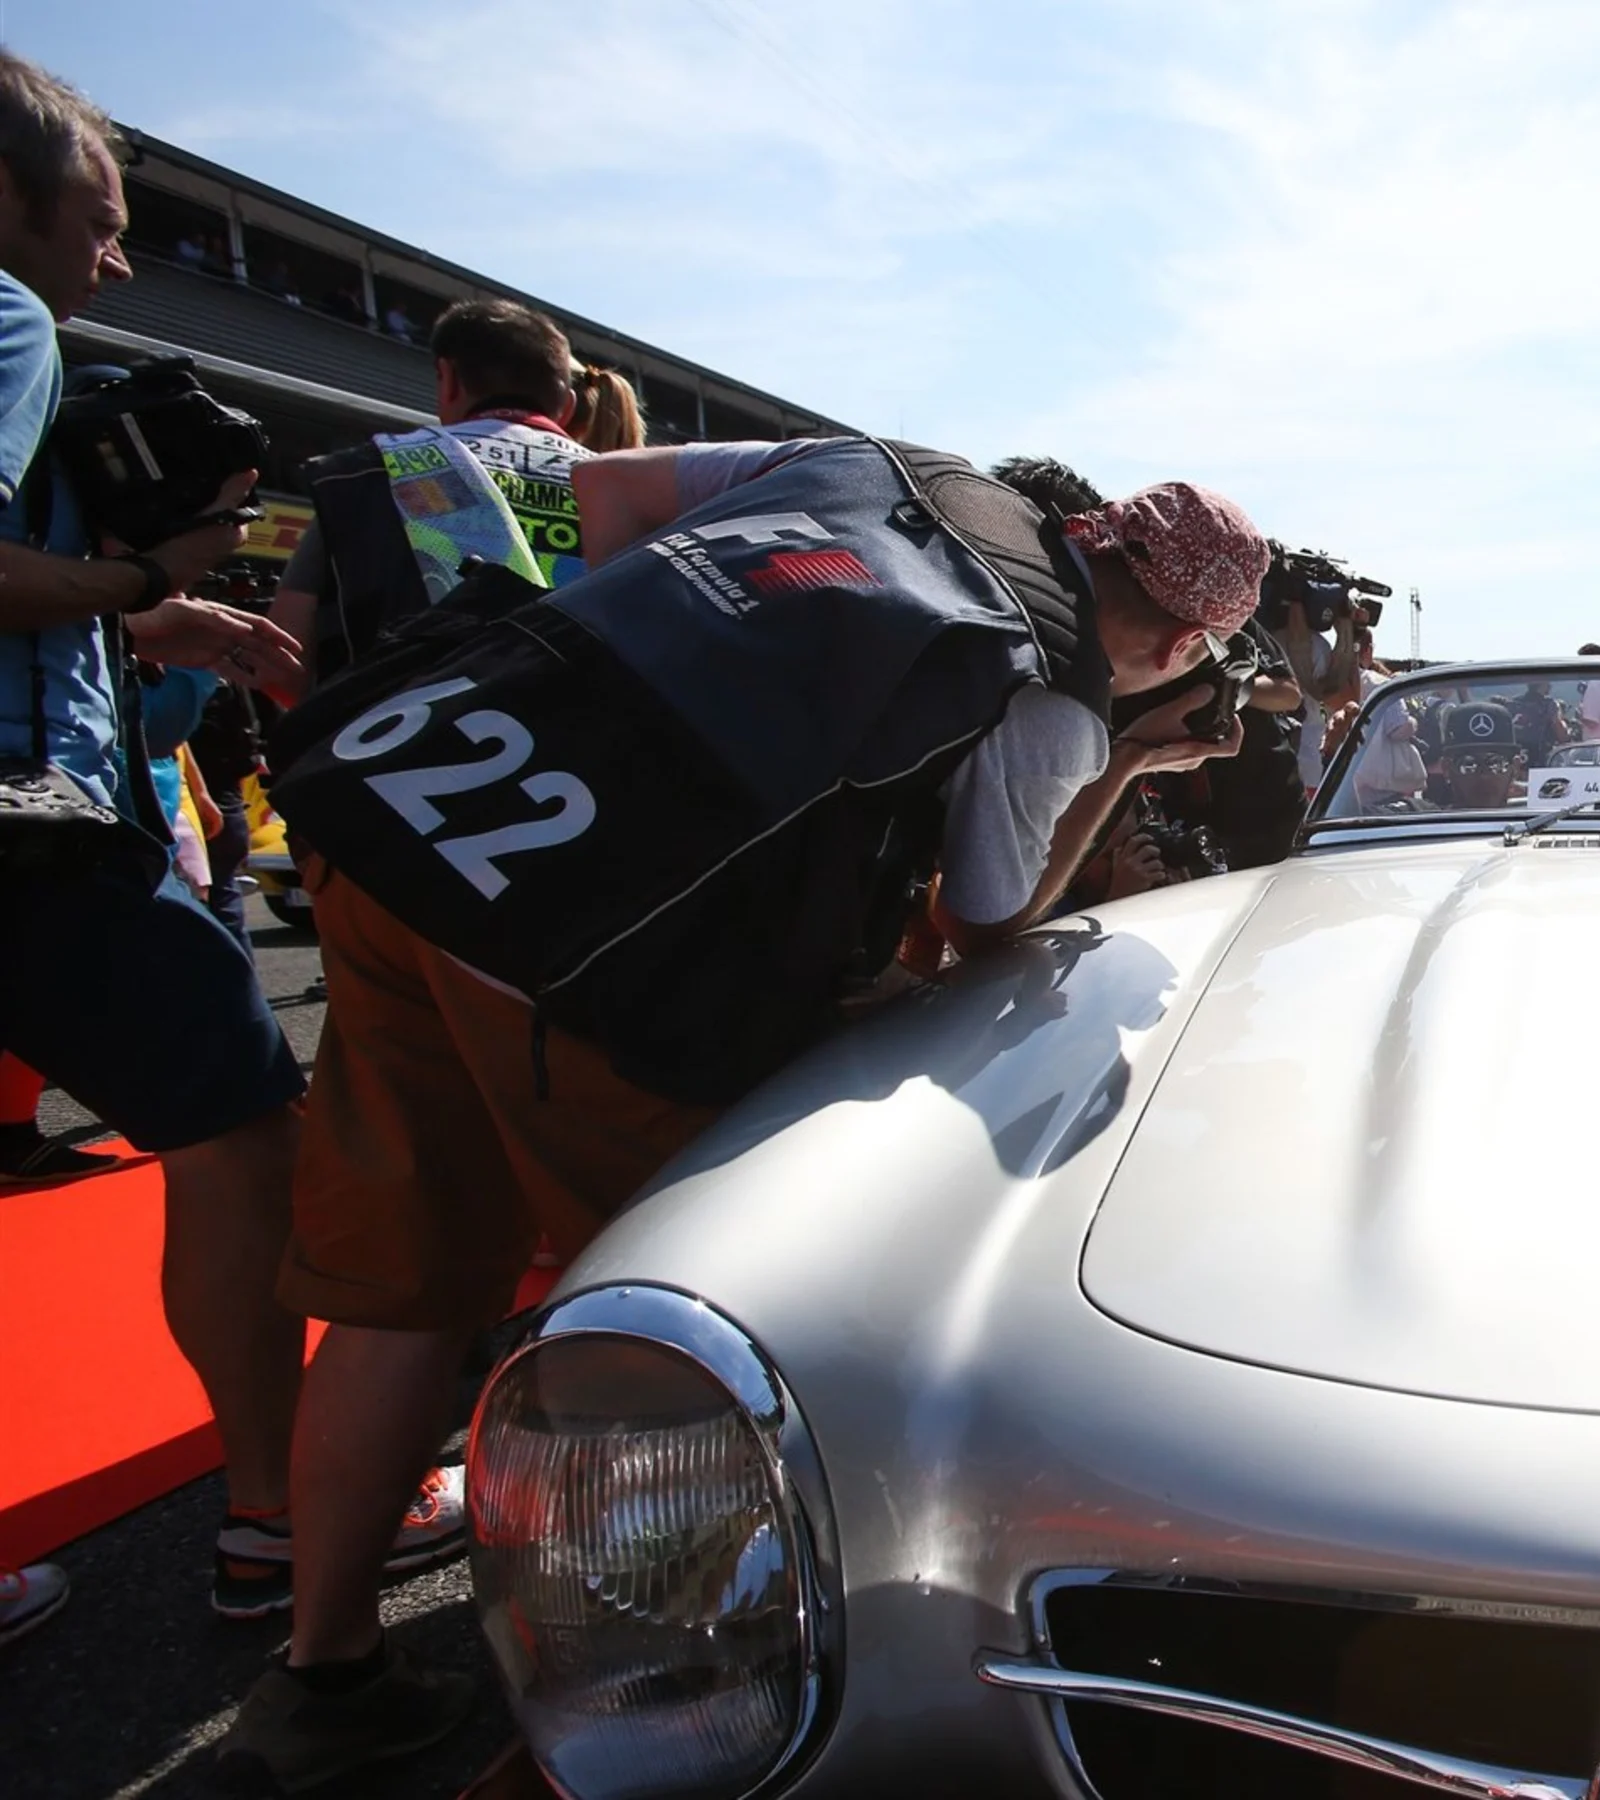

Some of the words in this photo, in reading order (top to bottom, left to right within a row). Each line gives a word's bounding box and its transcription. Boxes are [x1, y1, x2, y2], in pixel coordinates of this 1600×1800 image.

[495, 471, 574, 510] CHAMP
[517, 514, 578, 550] TO
[682, 547, 747, 600] Formula
[332, 676, 596, 902] 622
[1584, 783, 1600, 793] 44
